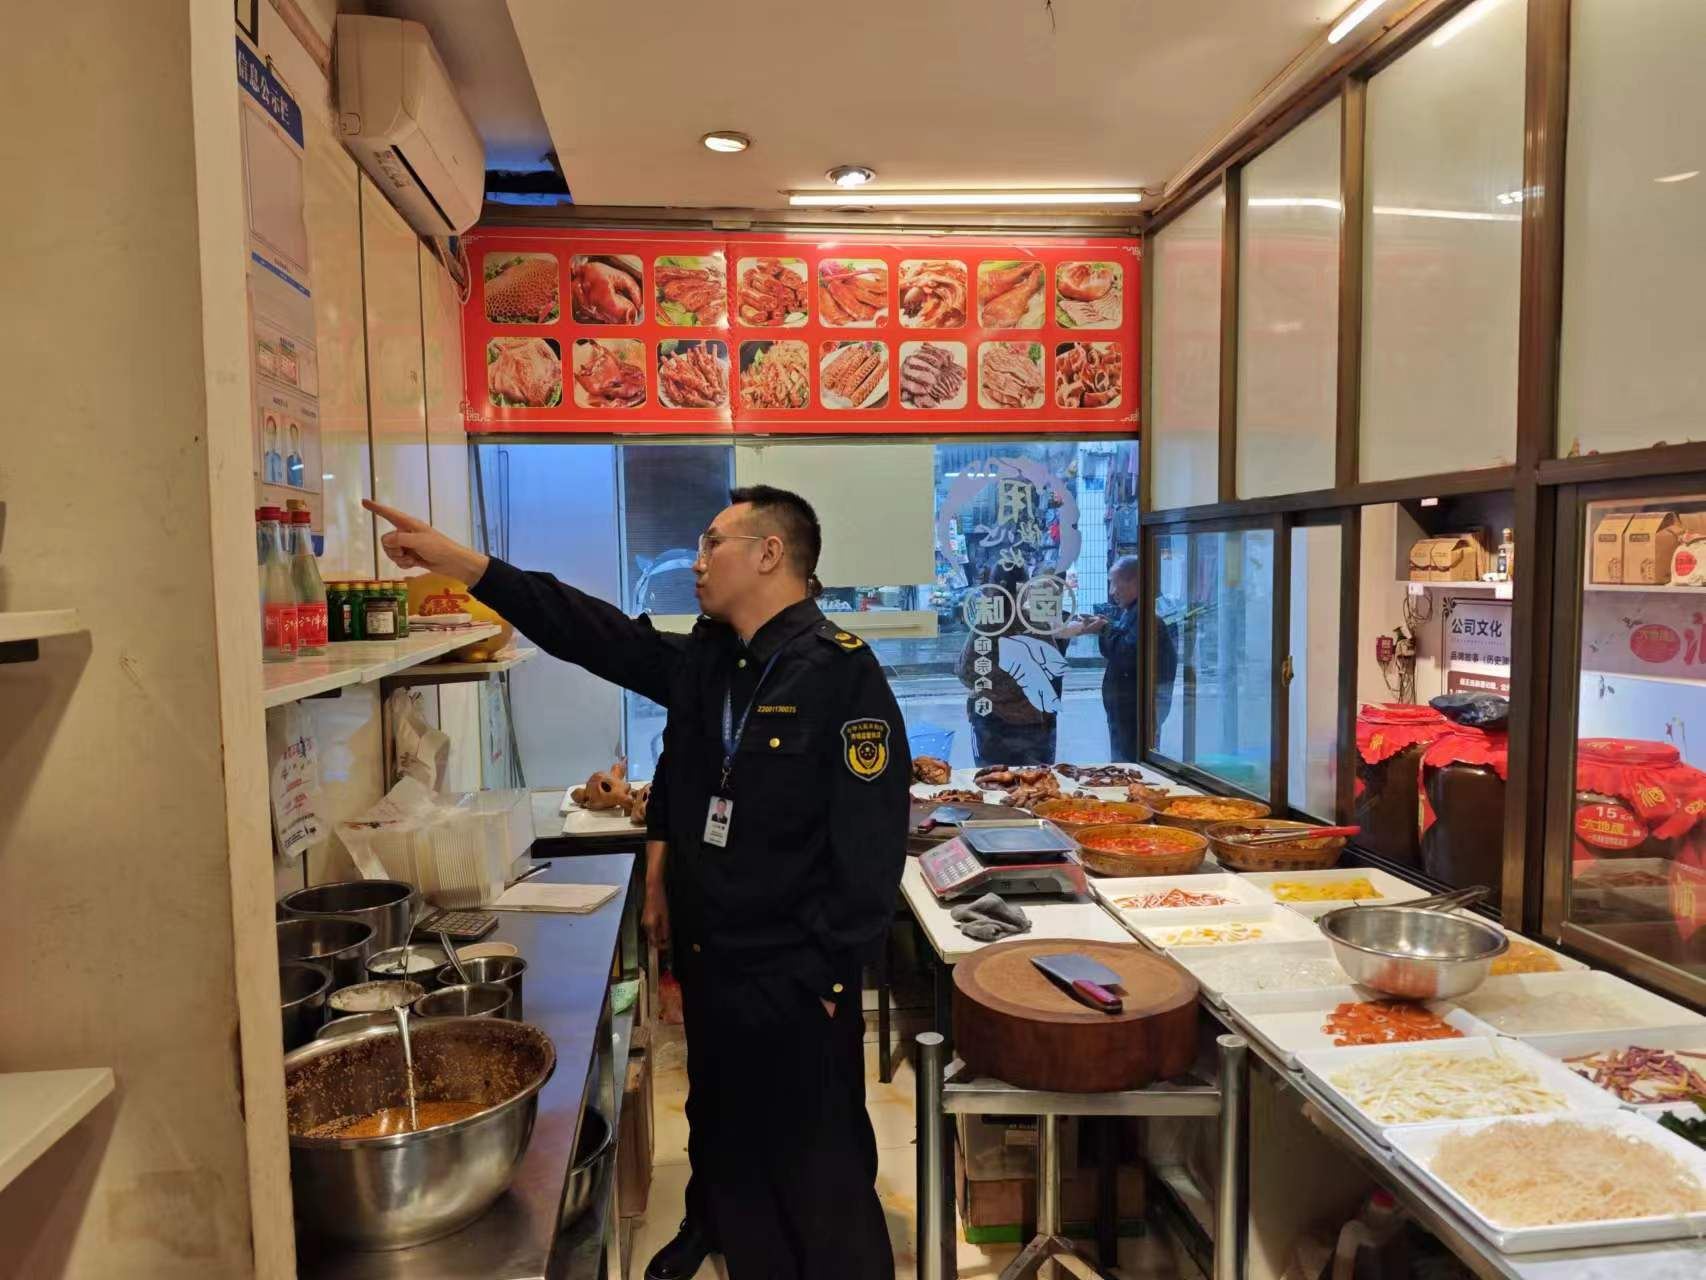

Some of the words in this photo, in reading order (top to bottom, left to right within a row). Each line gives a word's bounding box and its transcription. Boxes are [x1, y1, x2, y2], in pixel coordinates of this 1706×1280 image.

[1452, 618, 1502, 638] 公司文化
[1596, 806, 1617, 819] 15
